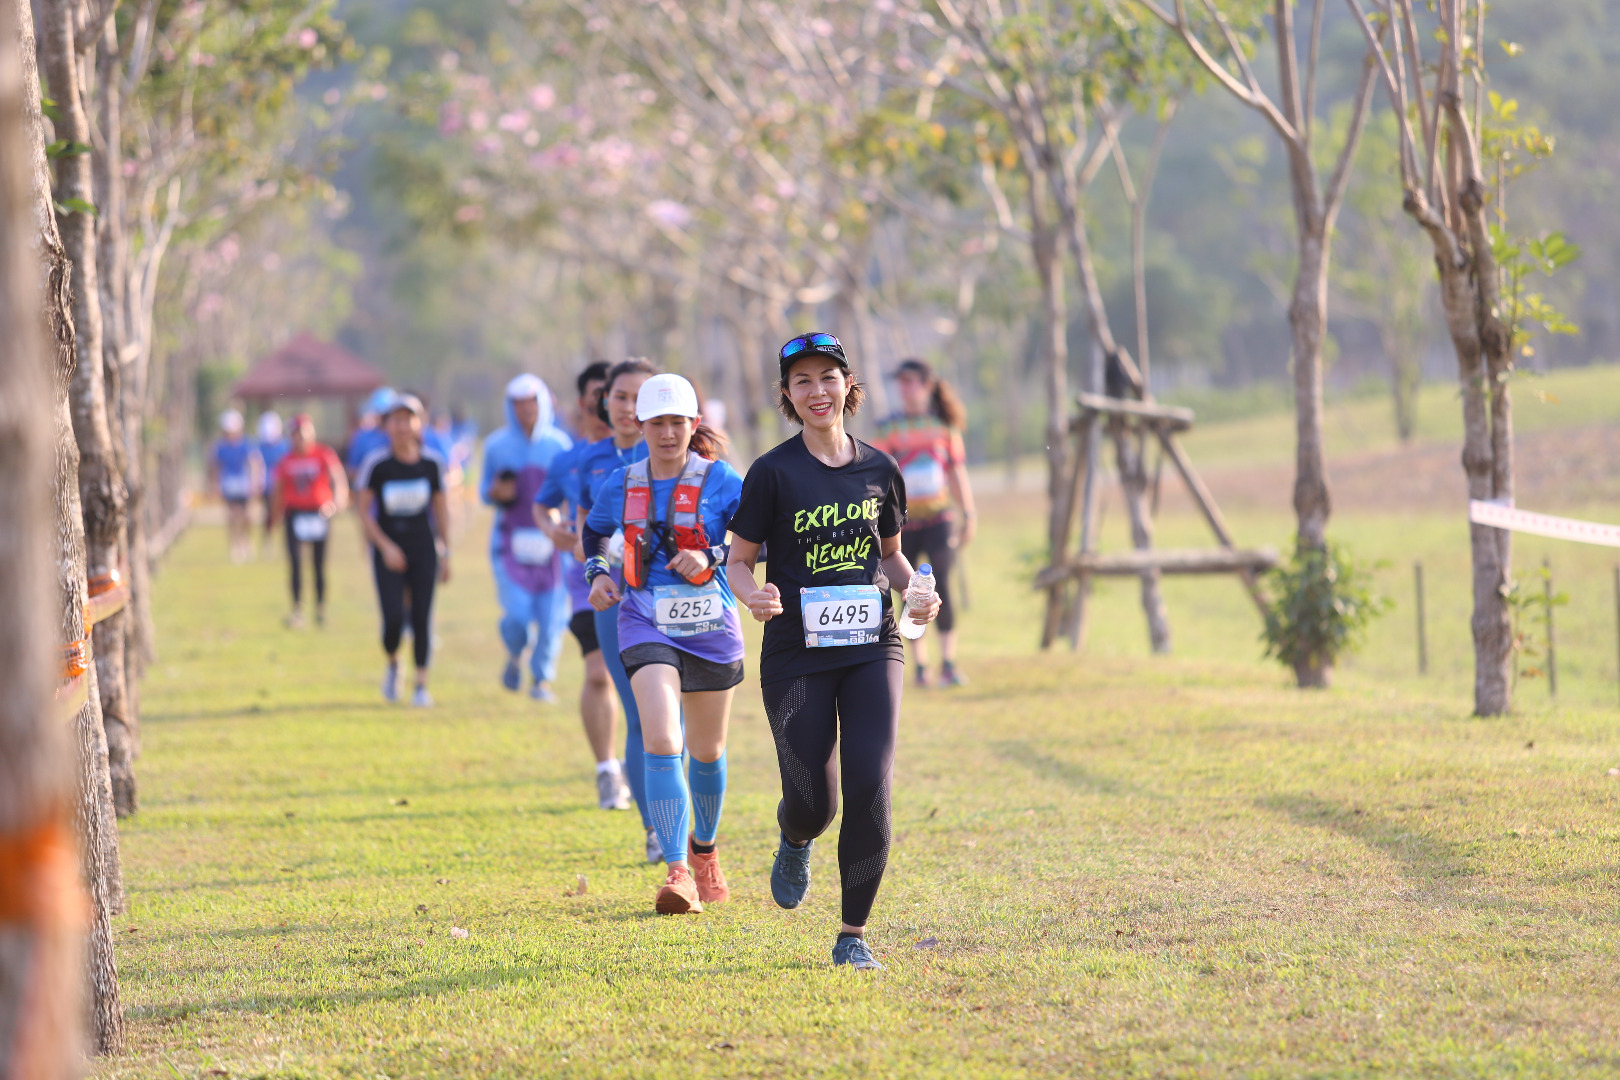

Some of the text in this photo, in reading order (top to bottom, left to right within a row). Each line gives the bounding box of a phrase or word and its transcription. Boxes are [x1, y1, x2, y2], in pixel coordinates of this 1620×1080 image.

[794, 497, 879, 532] EXPLORE
[797, 527, 863, 545] THE BEST
[806, 536, 872, 570] NEUNG
[669, 599, 712, 619] 6252
[819, 604, 869, 626] 6495
